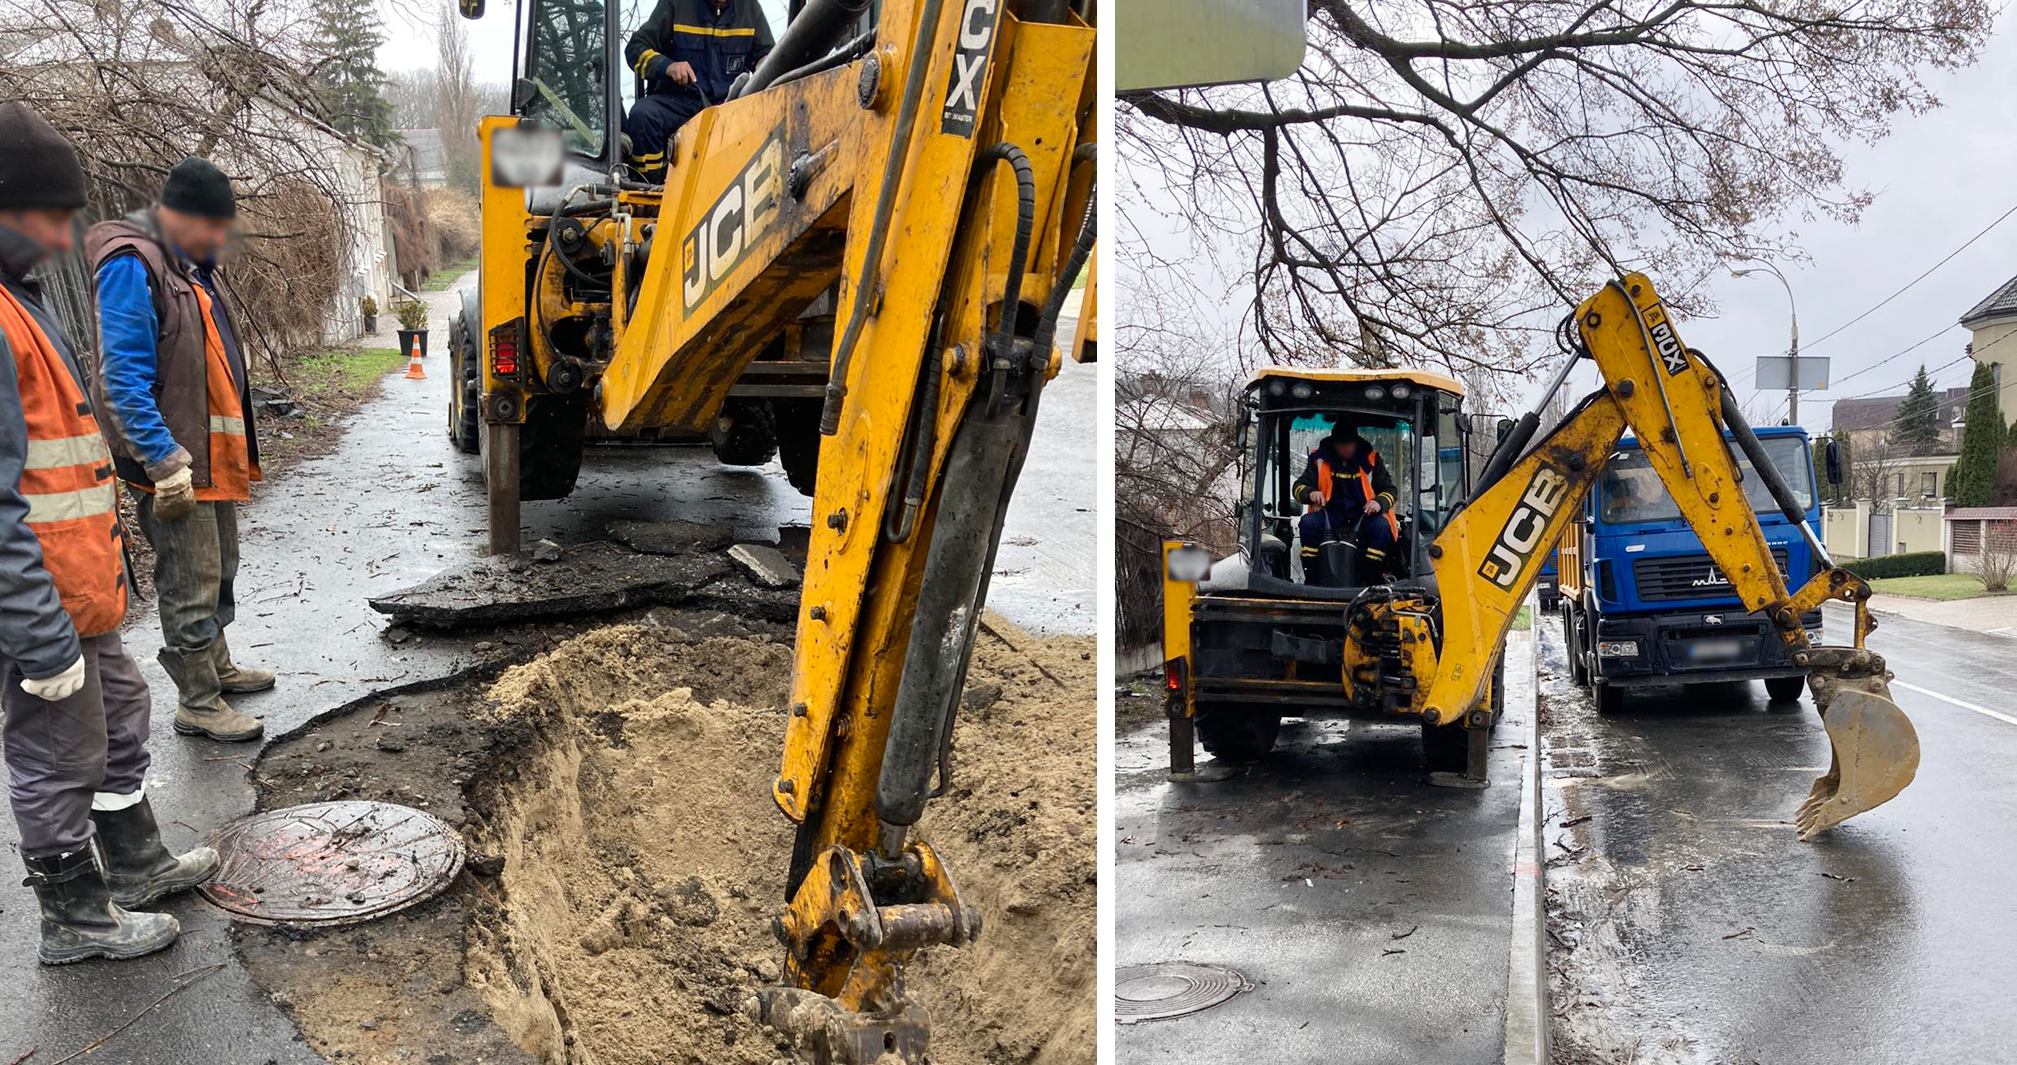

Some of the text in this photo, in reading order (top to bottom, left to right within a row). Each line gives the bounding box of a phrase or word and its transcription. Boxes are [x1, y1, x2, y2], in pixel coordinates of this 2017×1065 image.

[684, 138, 783, 309] JCB
[1651, 322, 1687, 372] 3CX
[1492, 468, 1569, 586] JCB
